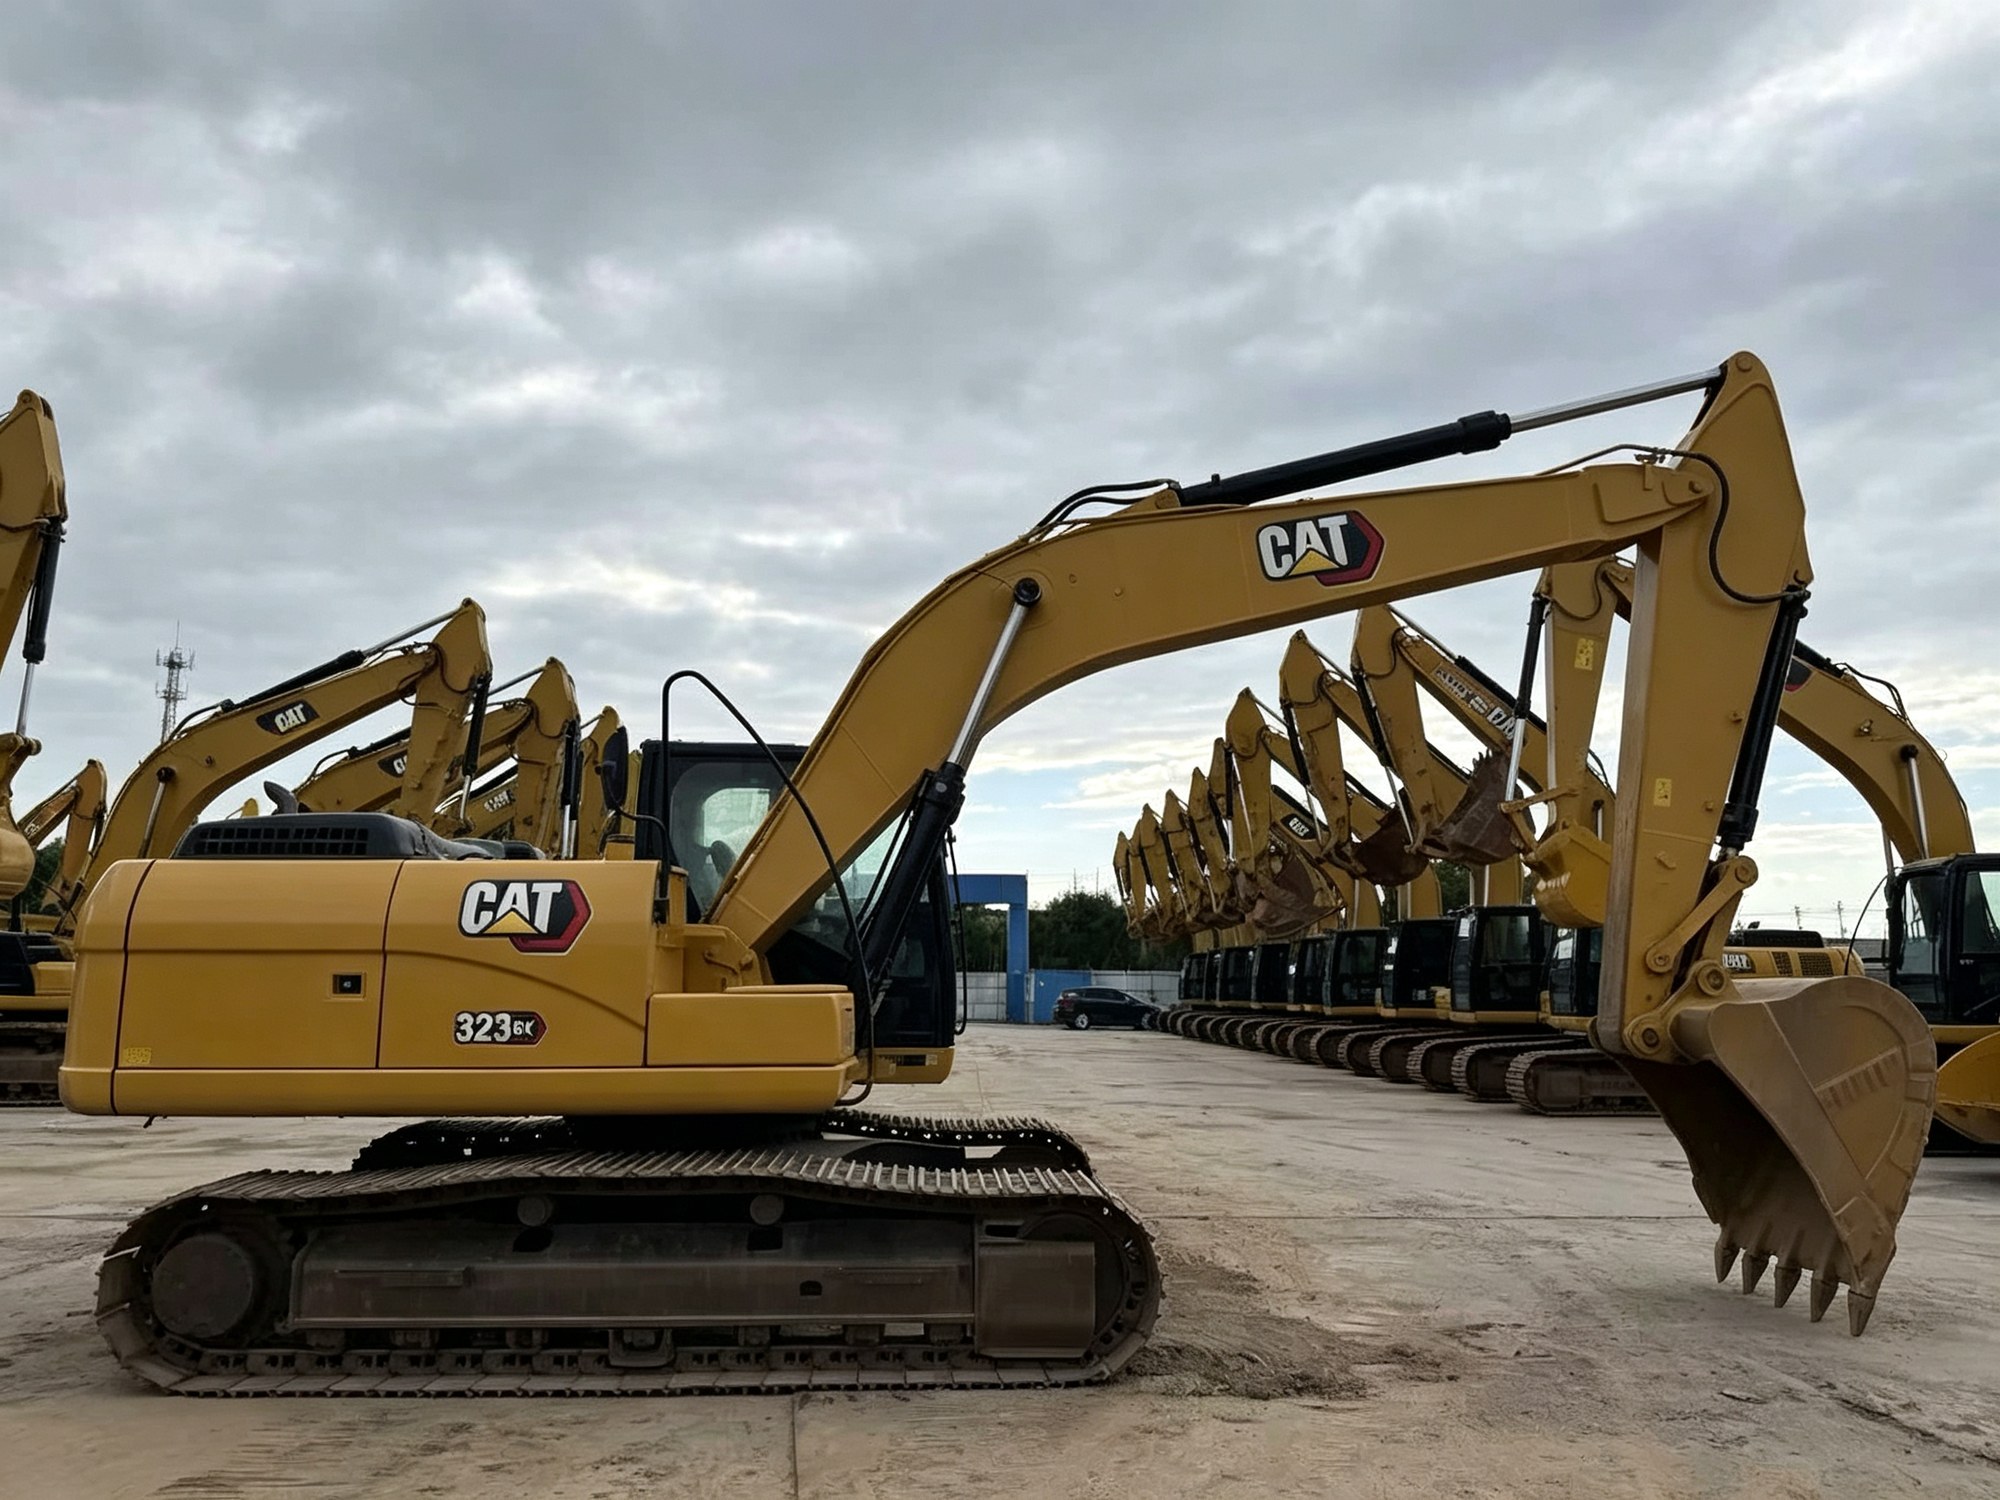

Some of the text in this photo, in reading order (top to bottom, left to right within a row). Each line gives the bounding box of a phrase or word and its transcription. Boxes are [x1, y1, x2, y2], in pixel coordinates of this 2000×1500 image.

[1258, 514, 1348, 578] CAT
[461, 881, 562, 934] CAT
[456, 1012, 511, 1042] 323
